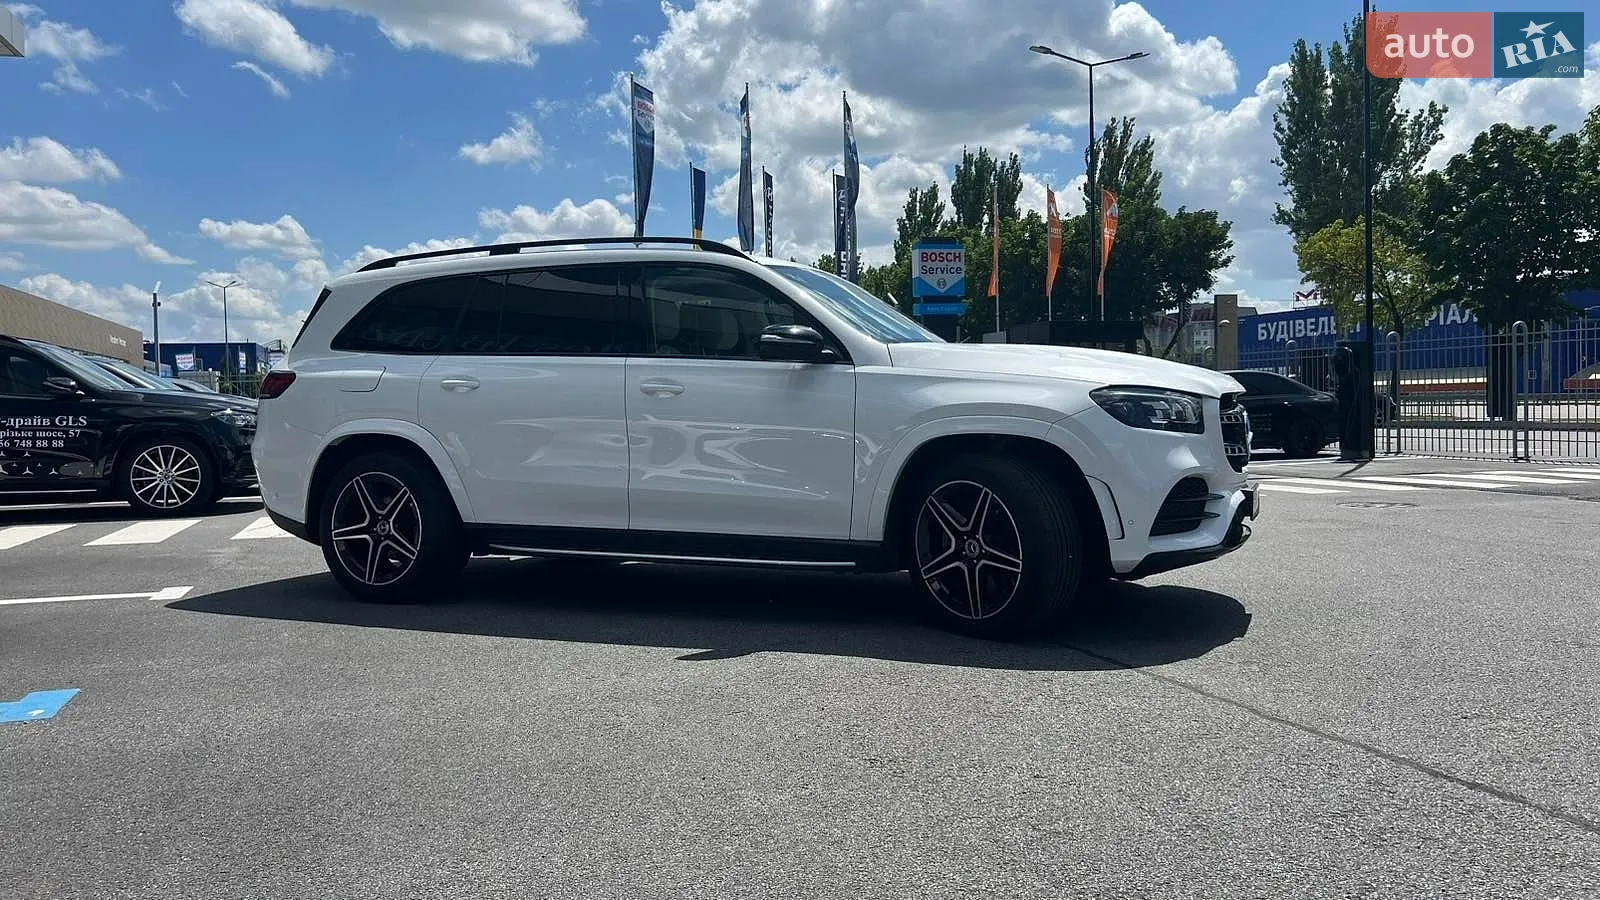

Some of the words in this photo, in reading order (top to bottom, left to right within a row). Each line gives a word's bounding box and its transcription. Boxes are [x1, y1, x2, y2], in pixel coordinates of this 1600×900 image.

[921, 252, 961, 262] BOSCH
[921, 265, 962, 275] Service
[0, 416, 50, 428] -драйв
[55, 416, 87, 426] GLS
[36, 431, 66, 439] шосе,
[68, 429, 81, 437] 57
[14, 439, 32, 448] 748
[36, 439, 48, 448] 88
[52, 439, 64, 448] 88
